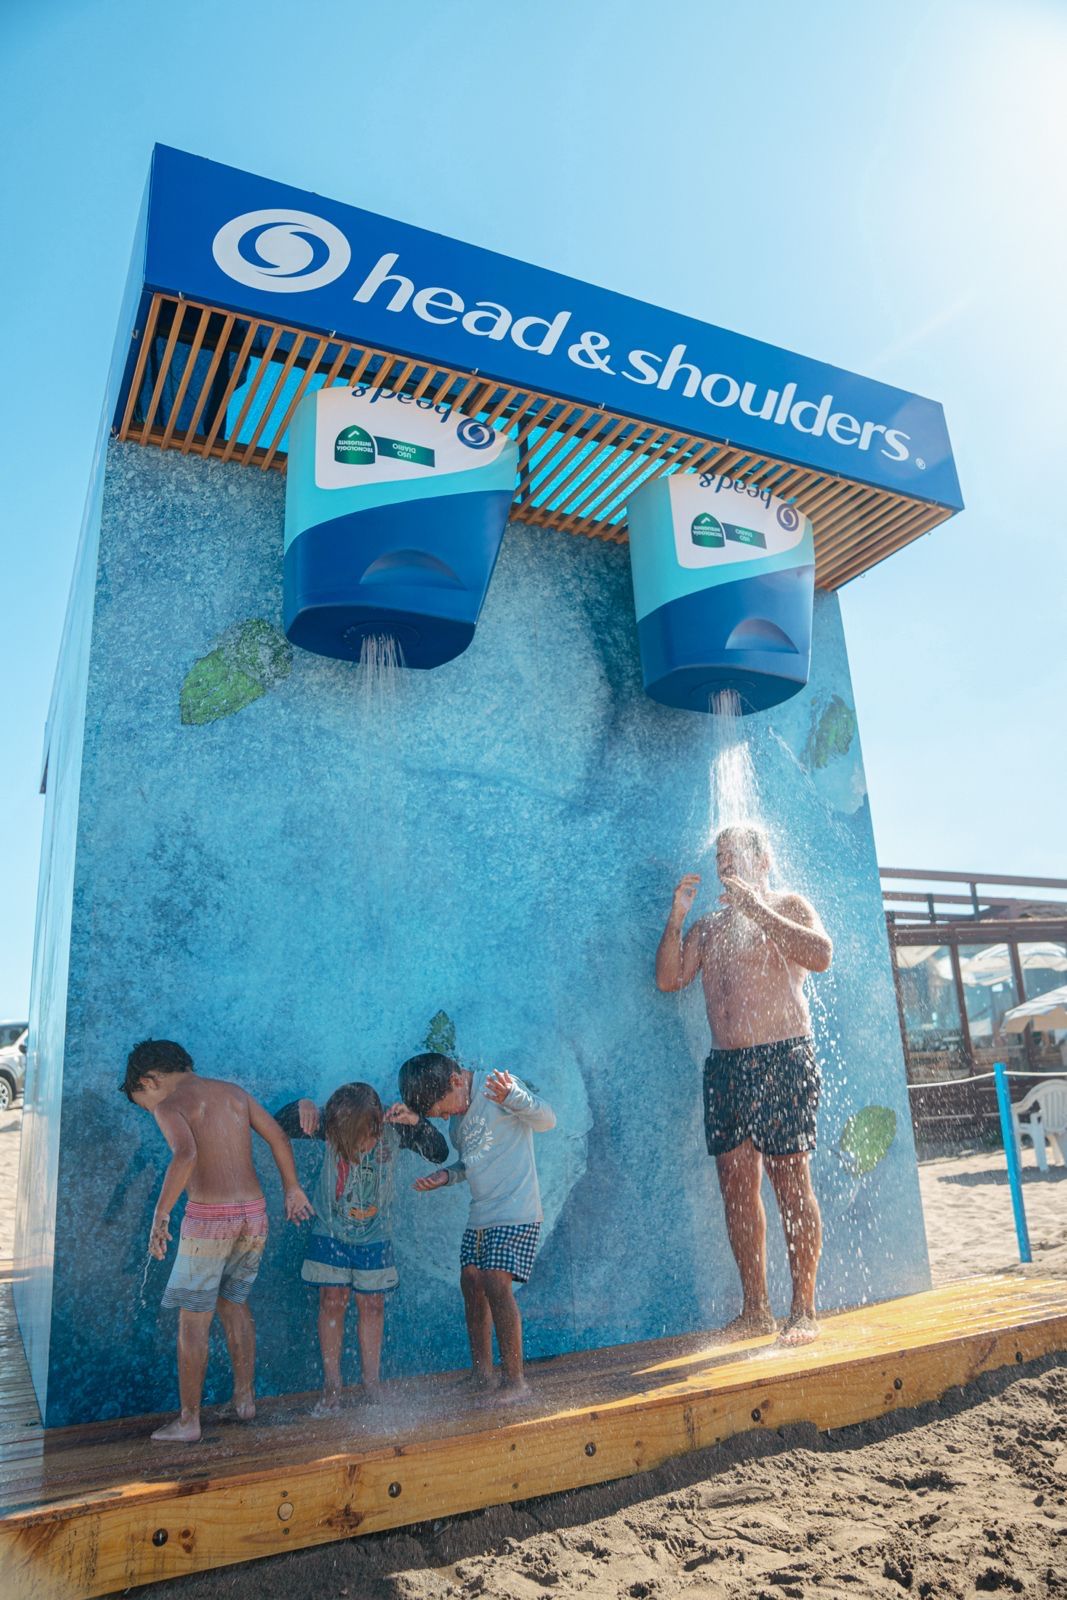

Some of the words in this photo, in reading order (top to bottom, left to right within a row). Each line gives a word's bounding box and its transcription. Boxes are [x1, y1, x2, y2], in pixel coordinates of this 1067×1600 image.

[353, 253, 572, 355] head
[568, 331, 616, 375] &
[621, 344, 911, 461] shoulders
[392, 443, 416, 454] DIARIO
[397, 450, 412, 459] USO
